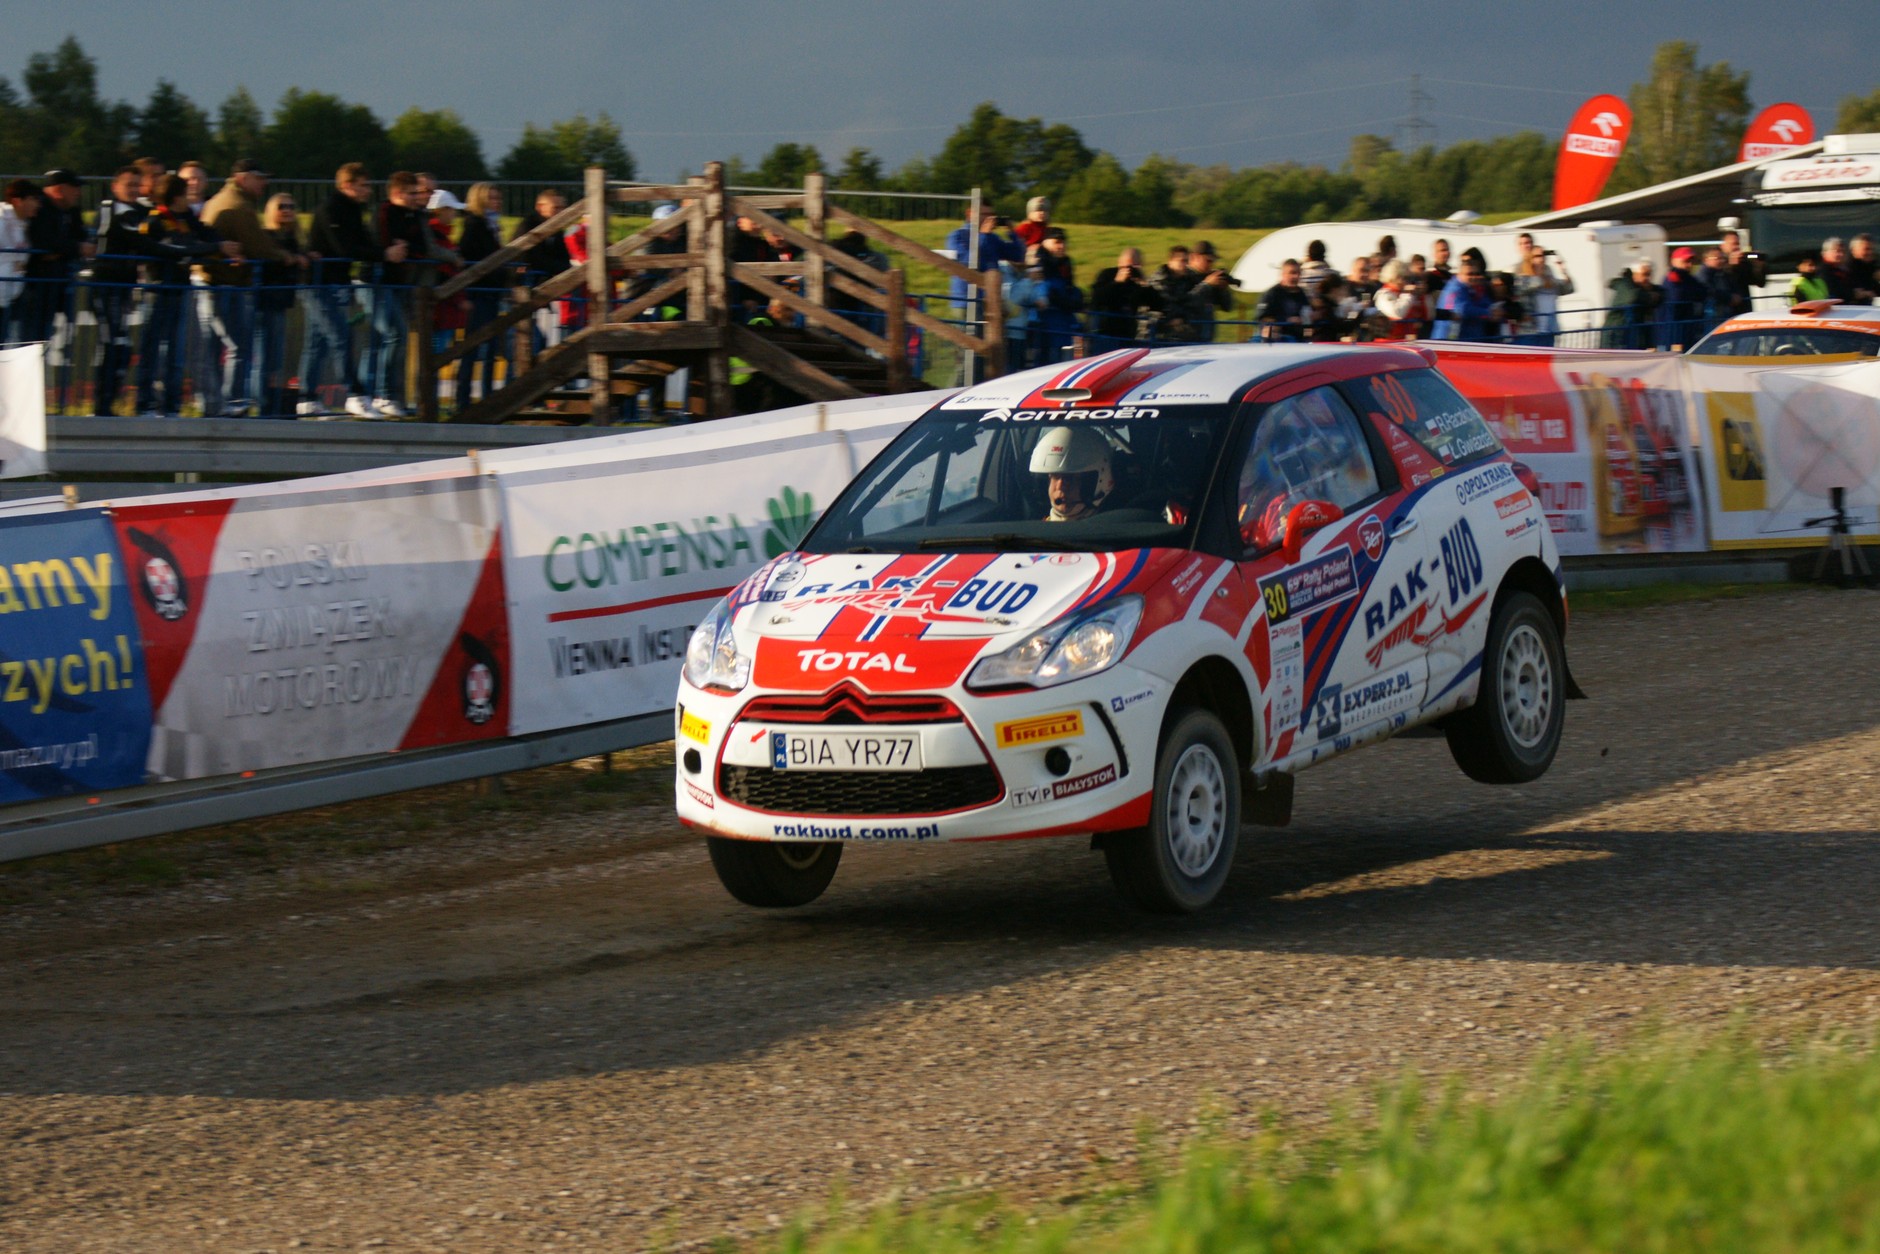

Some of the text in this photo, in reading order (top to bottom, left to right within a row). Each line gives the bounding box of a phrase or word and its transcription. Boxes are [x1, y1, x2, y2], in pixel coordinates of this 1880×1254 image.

[1012, 406, 1160, 421] CITROËN
[1370, 373, 1418, 425] 30
[1463, 464, 1512, 495] OPOLTRANS
[238, 540, 368, 590] POLSKI
[544, 513, 756, 593] COMPENSA
[1322, 555, 1350, 579] Poland
[1263, 583, 1288, 619] 30
[797, 648, 917, 673] TOTAL
[224, 655, 423, 718] MOTOROWY
[1343, 671, 1413, 713] EXPERT.PL
[1003, 714, 1078, 743] PIRELLI
[791, 738, 913, 766] BIA YR77
[1054, 765, 1115, 796] BIAŁYSTOK
[774, 823, 940, 841] rakbud.com.pl
